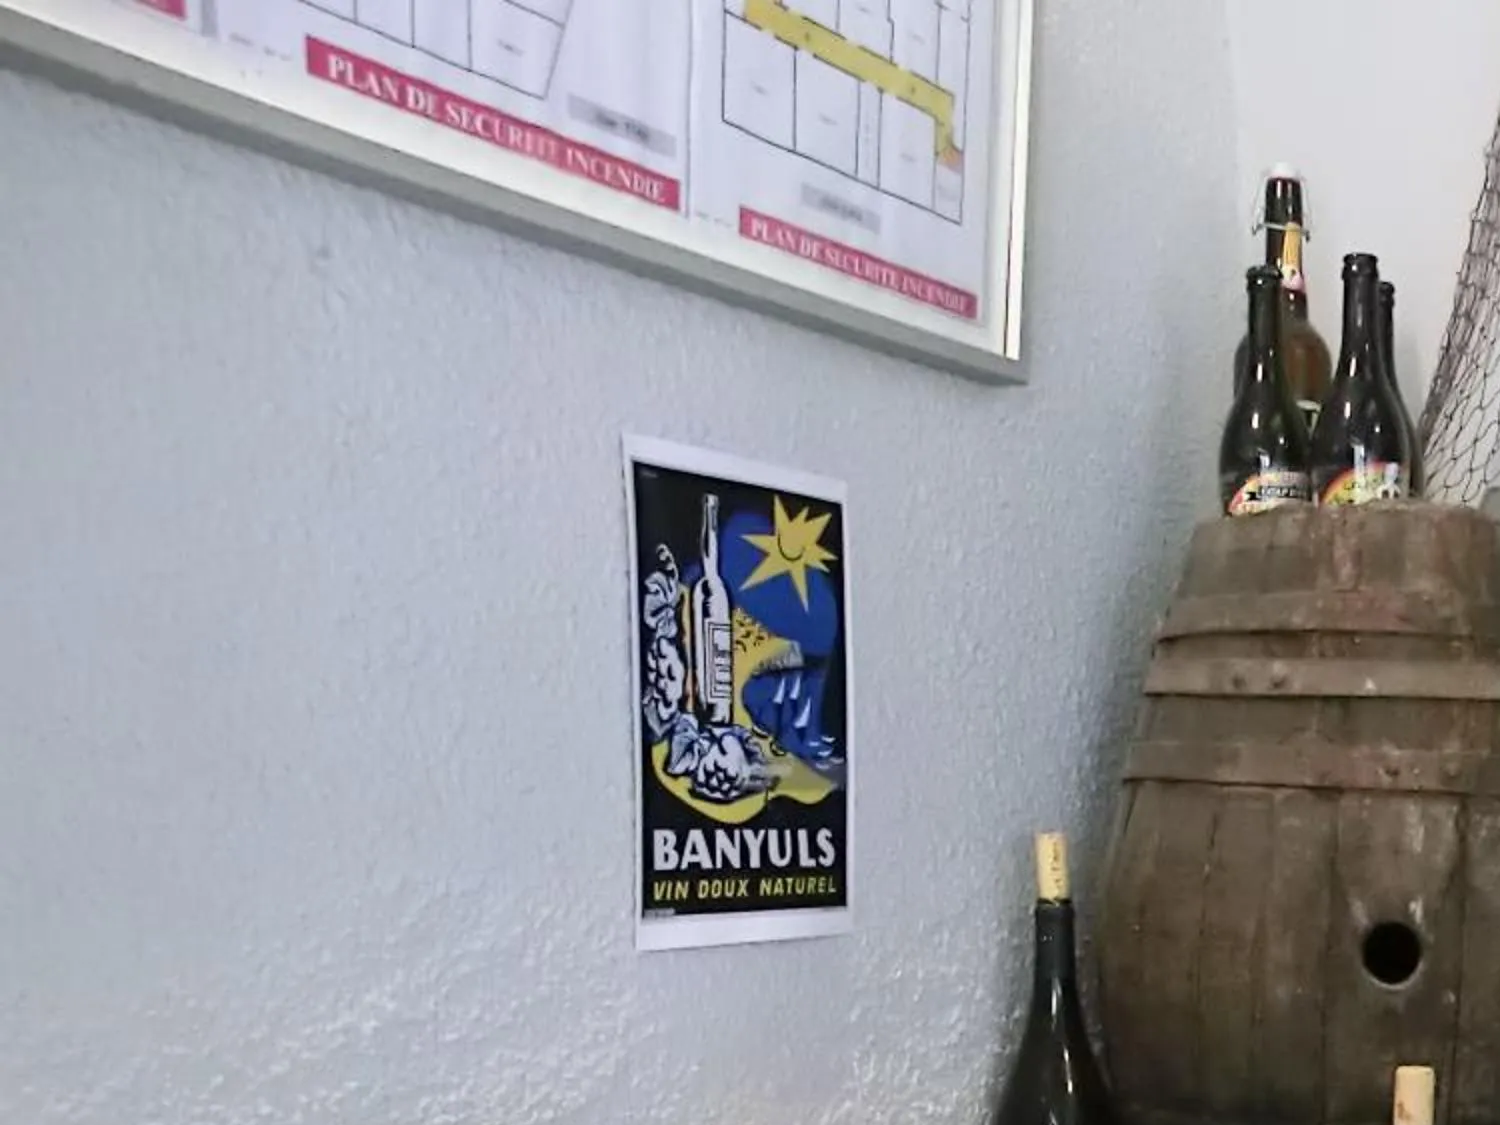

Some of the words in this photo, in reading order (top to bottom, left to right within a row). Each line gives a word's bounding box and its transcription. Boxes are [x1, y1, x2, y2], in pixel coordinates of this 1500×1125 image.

[328, 53, 400, 102] PLAN
[405, 84, 438, 115] DE
[566, 146, 666, 203] INCENDIE
[751, 219, 797, 251] PLAN
[653, 827, 836, 871] BANYULS
[653, 880, 690, 901] VIN
[697, 878, 749, 899] DOUX
[759, 875, 837, 897] NATUREL
